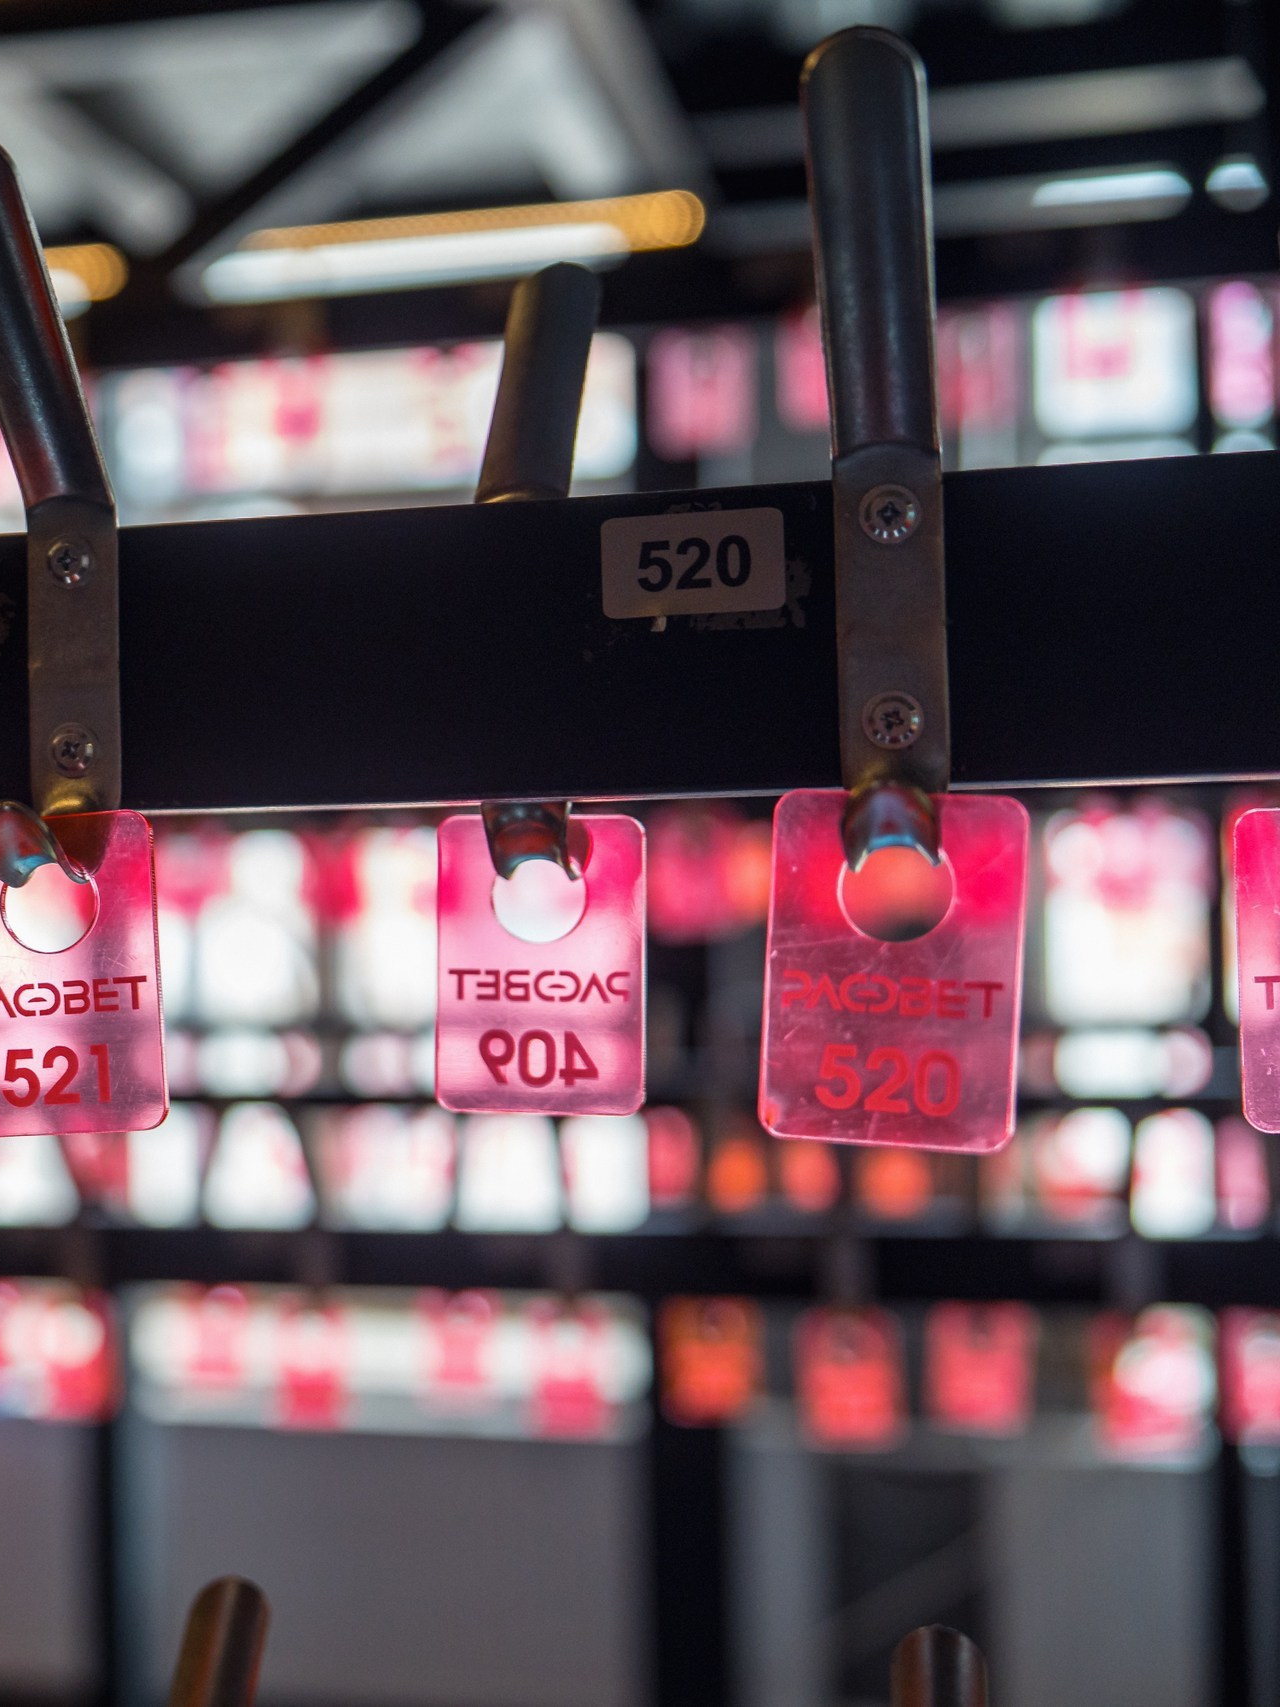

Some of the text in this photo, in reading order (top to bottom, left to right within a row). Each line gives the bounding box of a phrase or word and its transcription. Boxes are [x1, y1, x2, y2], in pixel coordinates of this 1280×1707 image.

[637, 534, 751, 592] 520
[2, 1043, 111, 1108] 521
[815, 1043, 961, 1117] 520
